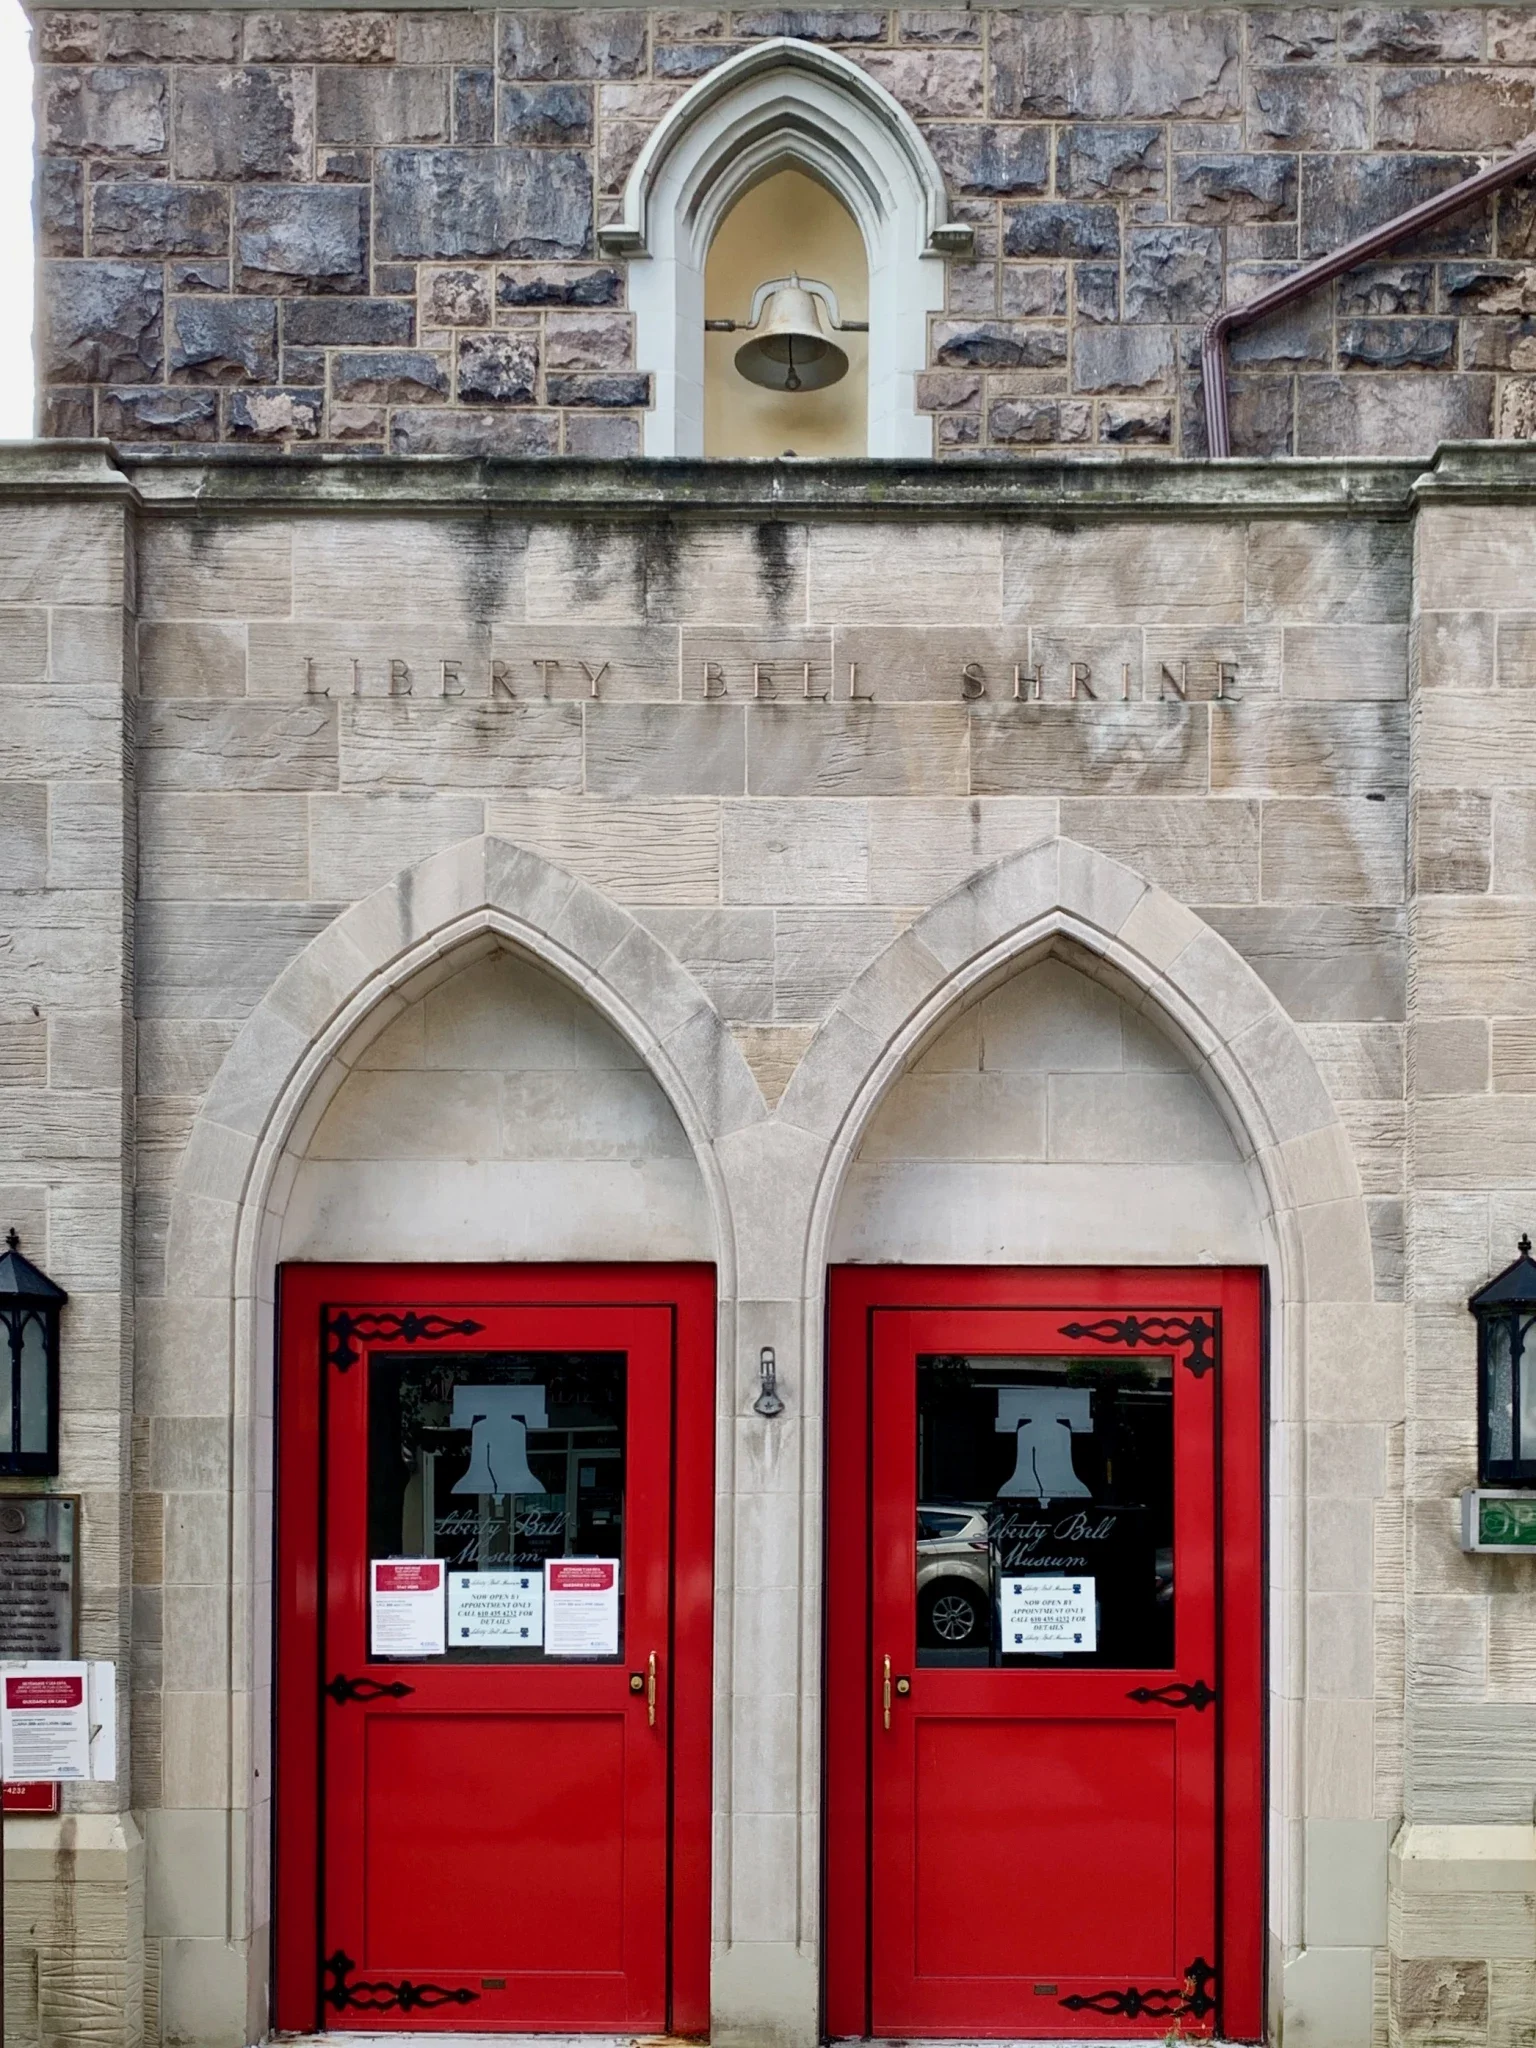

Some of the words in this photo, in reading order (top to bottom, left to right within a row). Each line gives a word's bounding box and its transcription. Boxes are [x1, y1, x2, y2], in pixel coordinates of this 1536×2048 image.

[303, 657, 610, 698] LIBERTY
[703, 661, 876, 700] BELL
[961, 662, 1243, 701] SHRINE
[434, 1509, 505, 1548] Liberty
[508, 1510, 571, 1537] Bell
[985, 1512, 1051, 1552] Liberty
[1053, 1511, 1117, 1541] Bell
[445, 1538, 542, 1565] Museum
[1003, 1542, 1088, 1568] Museum
